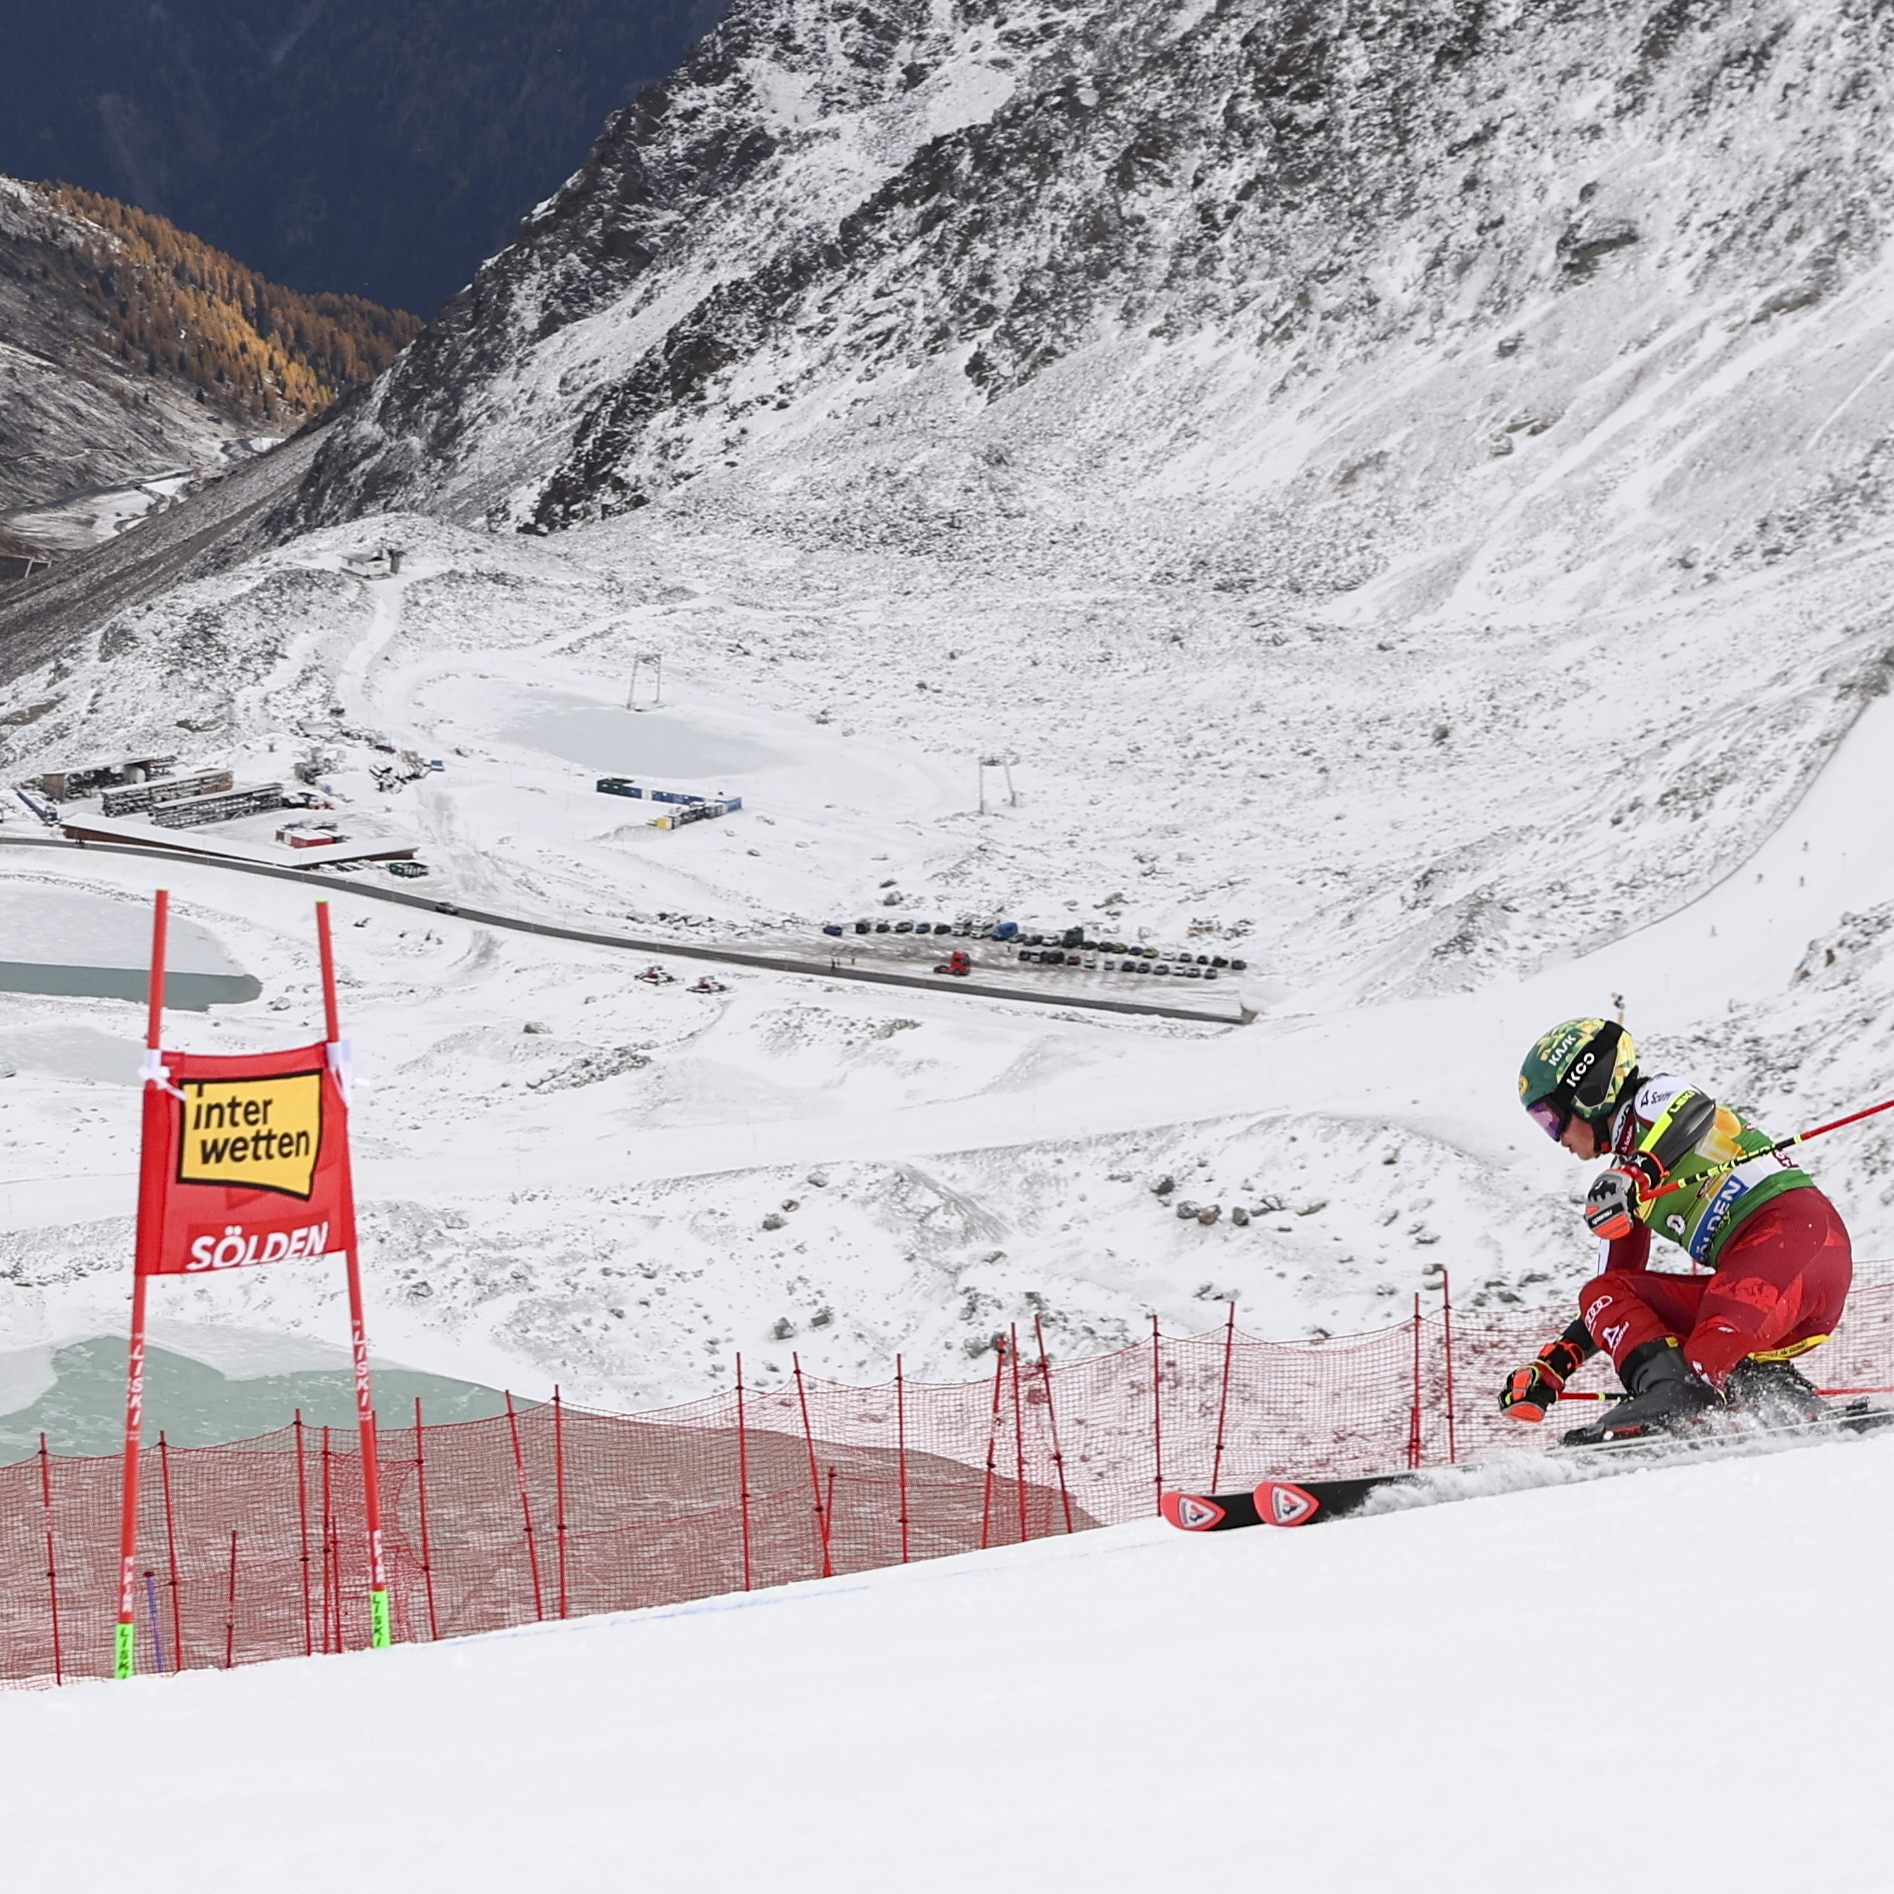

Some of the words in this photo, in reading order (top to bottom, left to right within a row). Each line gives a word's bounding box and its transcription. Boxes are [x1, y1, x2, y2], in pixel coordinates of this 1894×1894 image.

[1548, 1034, 1577, 1067] KASK
[193, 1084, 274, 1130] inter
[200, 1129, 310, 1165] wetten
[186, 1221, 329, 1271] SÖLDEN
[128, 1344, 144, 1426] LISKI
[354, 1330, 369, 1408] LISKI
